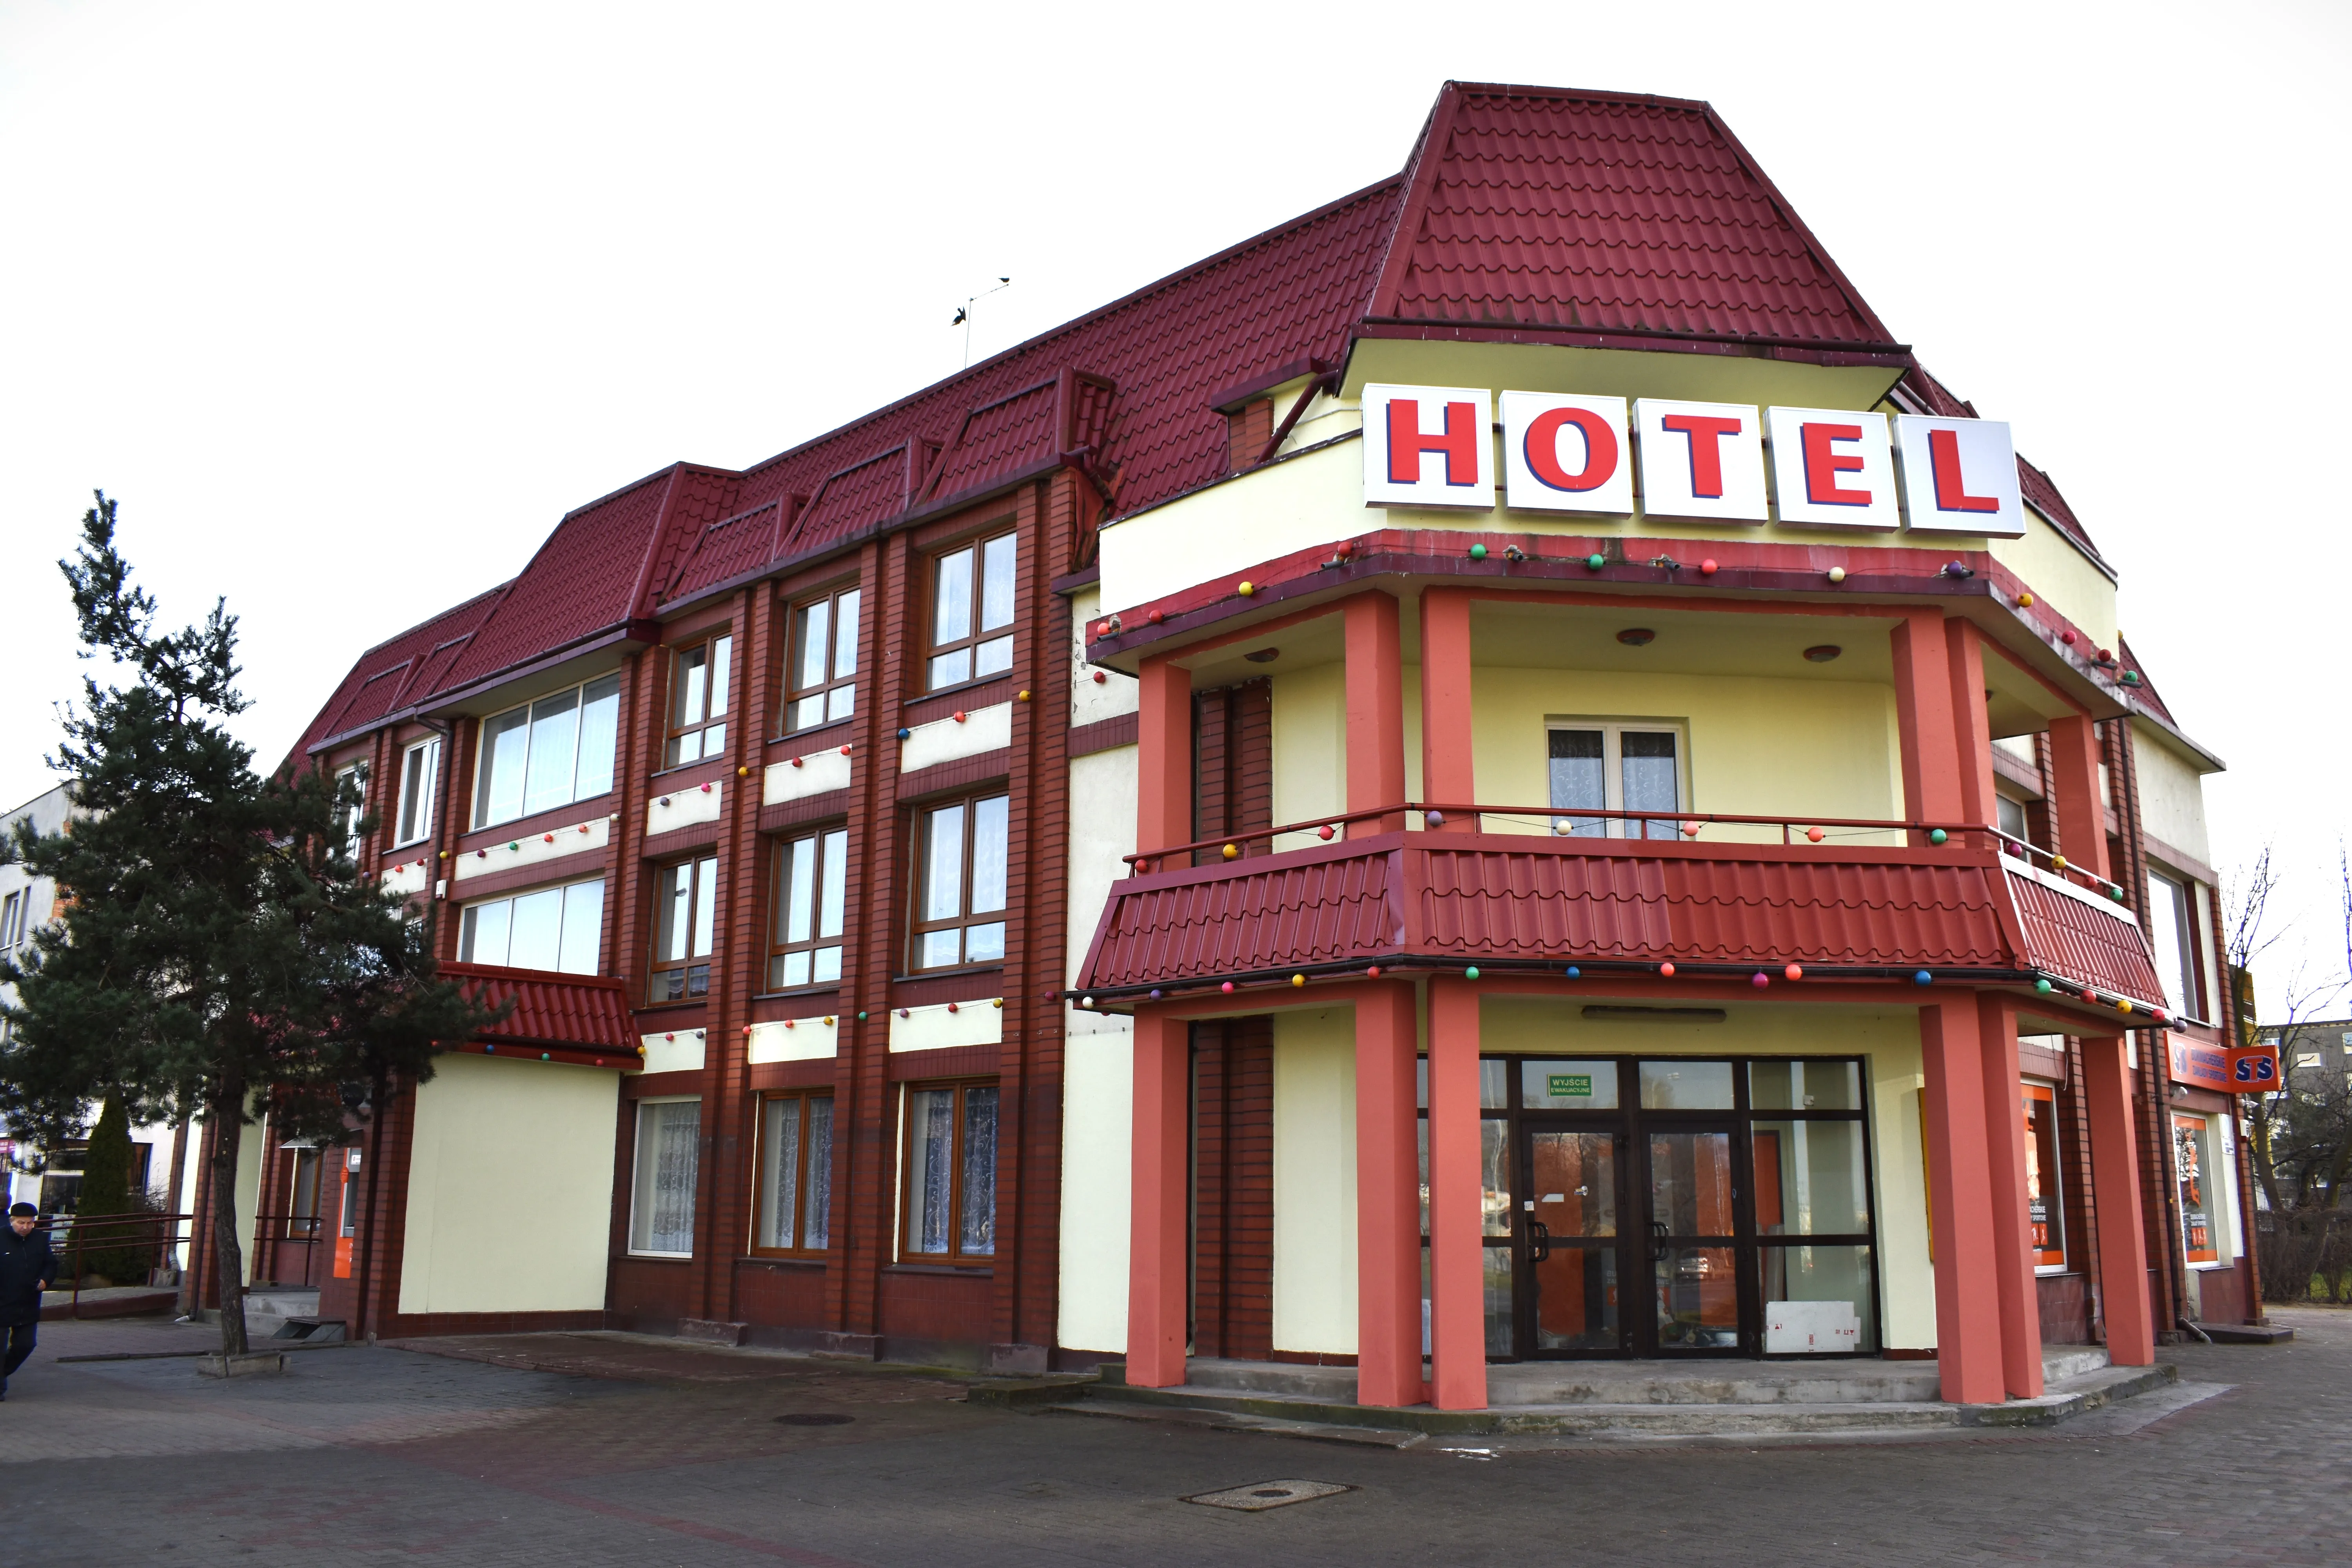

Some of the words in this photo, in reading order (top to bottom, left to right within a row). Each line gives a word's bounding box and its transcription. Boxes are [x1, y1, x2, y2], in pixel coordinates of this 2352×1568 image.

[1386, 399, 2000, 514] HOTEL
[1552, 1078, 1588, 1086] WYJŚCIE
[2234, 1055, 2274, 1083] STS
